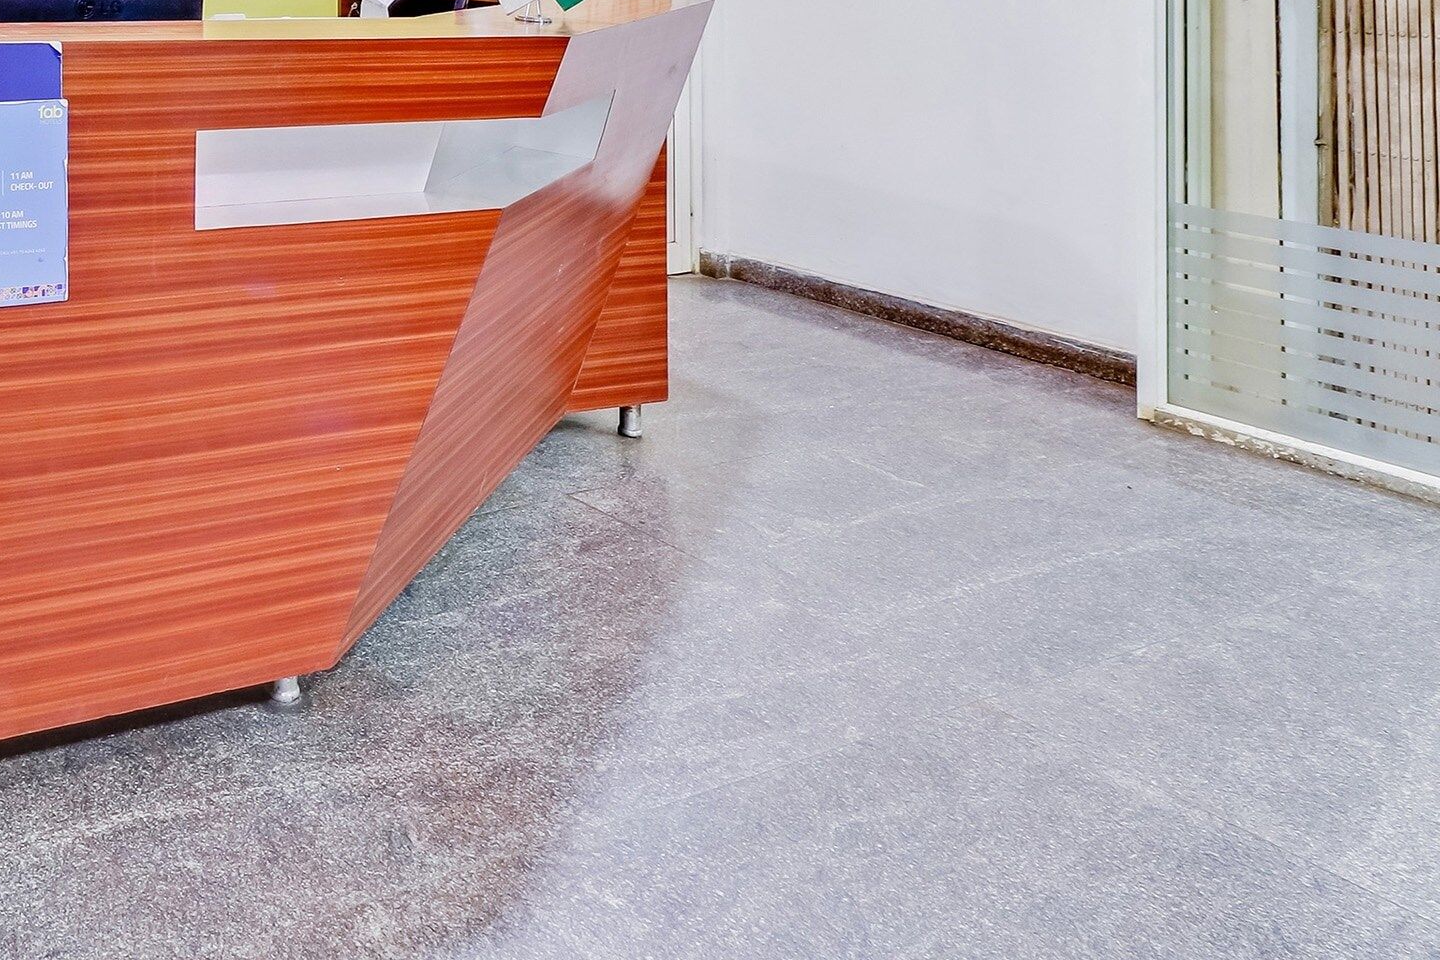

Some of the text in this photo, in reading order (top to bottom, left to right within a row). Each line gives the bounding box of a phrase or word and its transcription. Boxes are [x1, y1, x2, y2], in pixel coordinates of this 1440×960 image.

[38, 105, 63, 118] fab
[10, 171, 33, 180] 11 AM
[1, 211, 11, 219] 10
[11, 210, 24, 218] AM
[7, 220, 37, 230] TIMINGS
